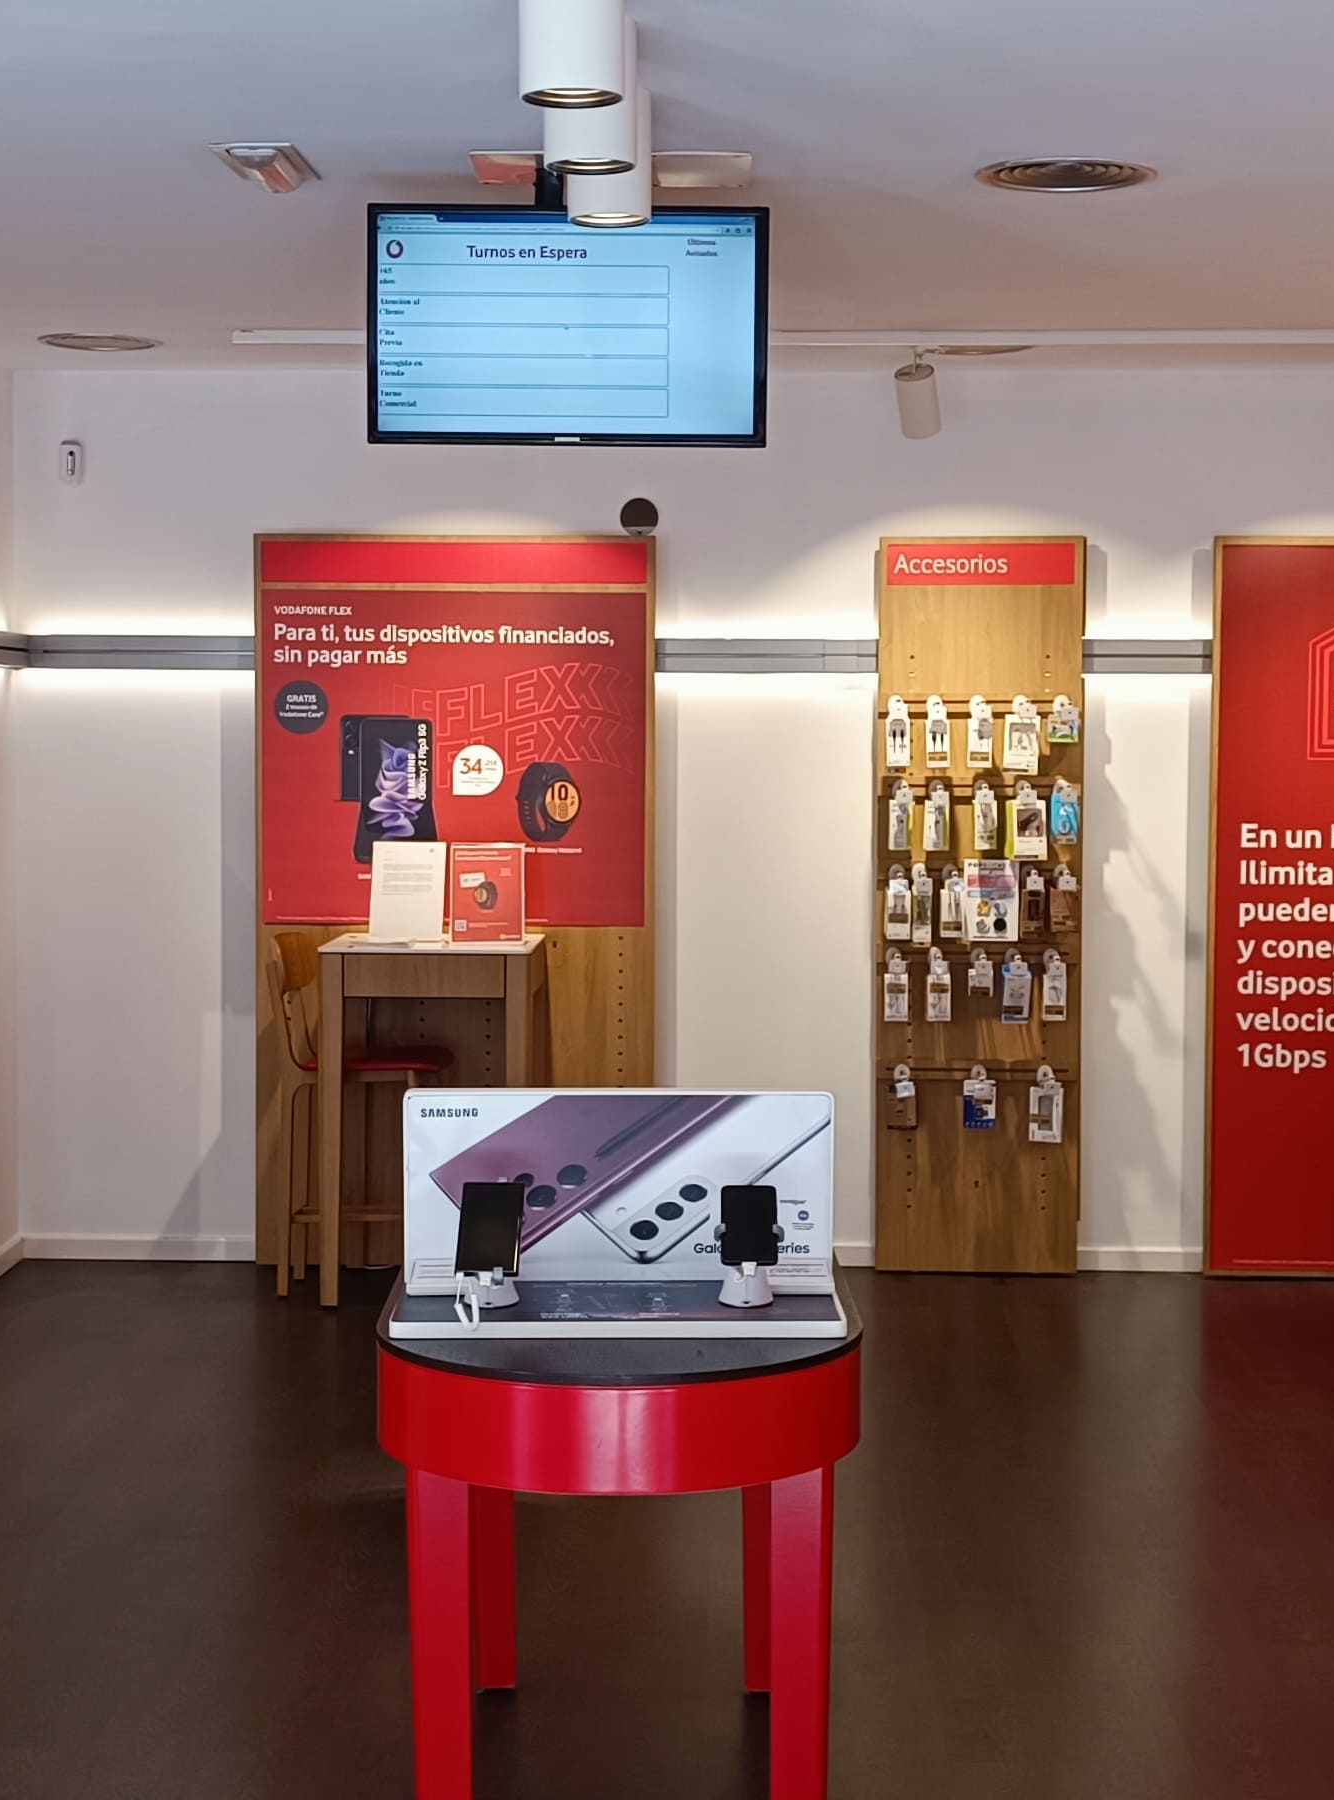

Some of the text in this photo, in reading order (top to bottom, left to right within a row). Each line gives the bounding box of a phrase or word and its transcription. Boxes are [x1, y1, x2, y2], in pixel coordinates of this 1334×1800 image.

[467, 246, 587, 261] Turnos en Espera
[893, 554, 1008, 574] Accesorios
[274, 605, 352, 615] VODAFONE FLEX
[274, 623, 615, 647] Para ti, tus dispositivos financiados,
[273, 645, 408, 667] sin pagar más
[287, 694, 317, 702] GRATIS
[459, 757, 483, 775] 34
[1240, 823, 1277, 849] En
[1285, 829, 1322, 849] un
[1237, 940, 1255, 964] y
[1237, 1043, 1327, 1074] 1Gbps
[420, 1107, 479, 1119] SAMSUNG
[777, 1242, 810, 1254] eries
